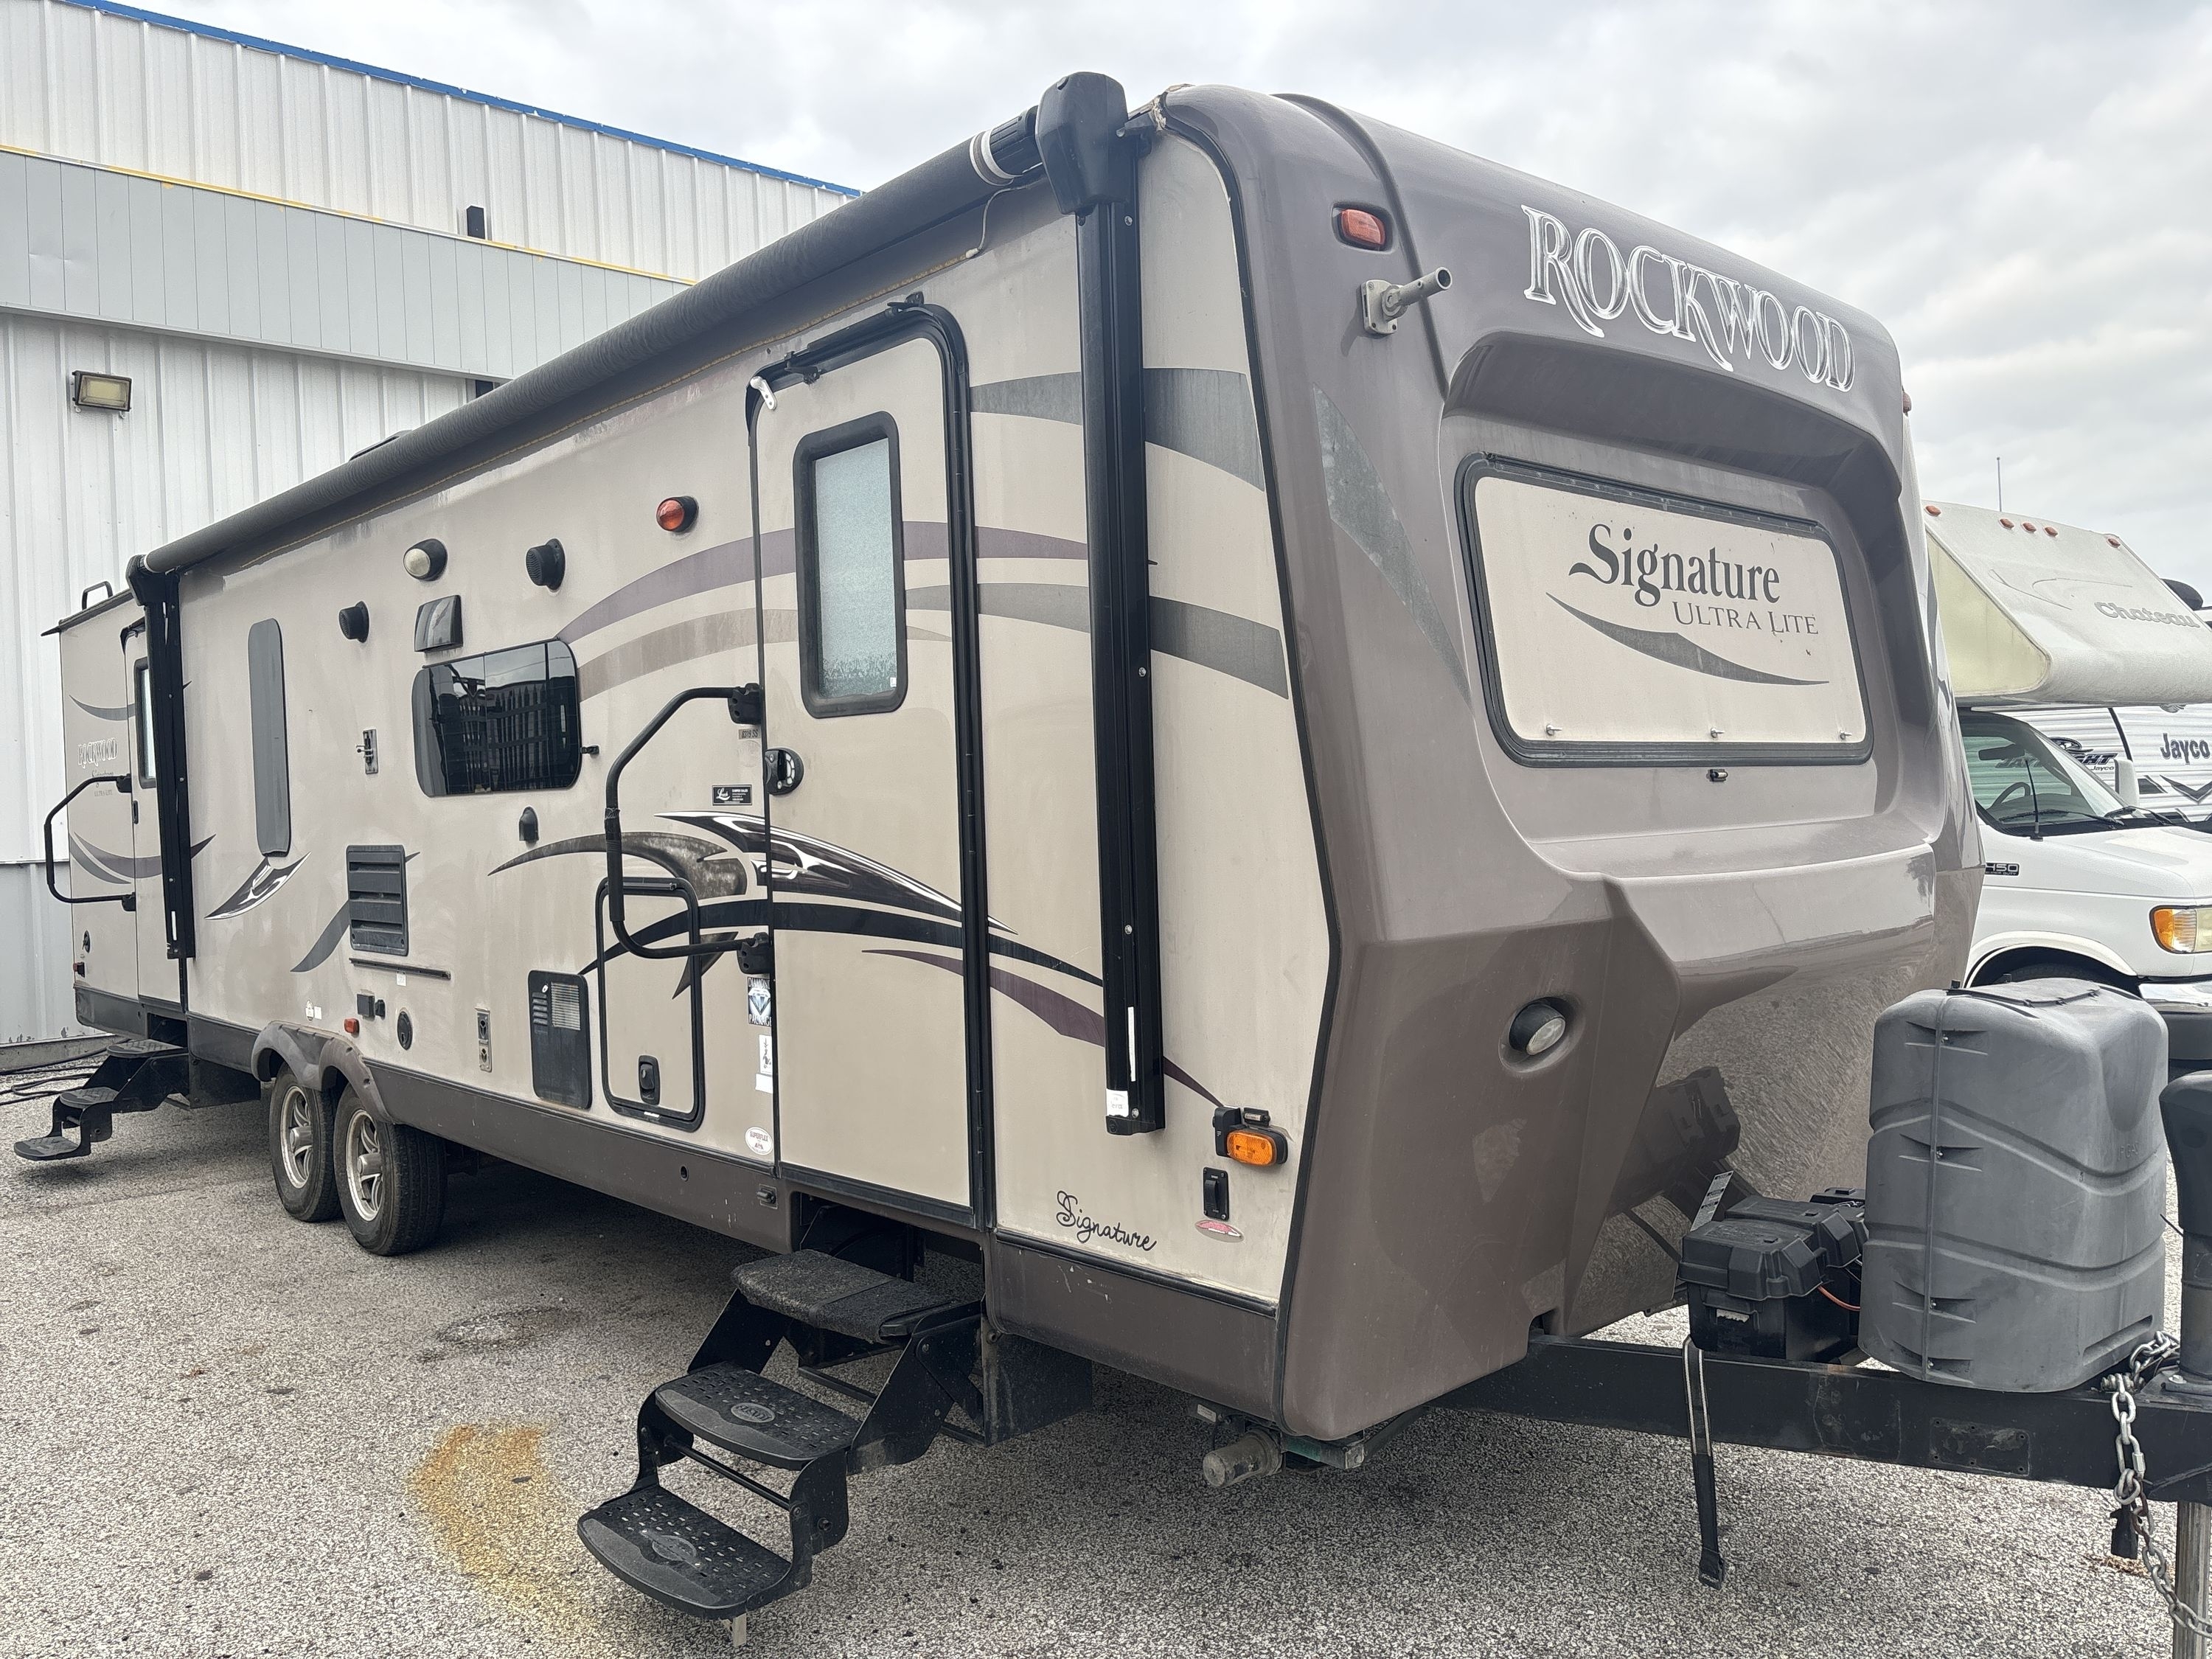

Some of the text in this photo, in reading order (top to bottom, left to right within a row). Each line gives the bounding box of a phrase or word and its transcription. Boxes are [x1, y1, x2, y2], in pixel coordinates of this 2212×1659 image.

[1520, 204, 1856, 392] ROCKWOOD
[1568, 524, 1781, 607] Signature
[1672, 602, 1819, 635] ULTRA LITE
[2094, 602, 2200, 627] Chateau
[77, 737, 118, 769] ROCKWOOD
[2160, 732, 2211, 765] Jayco
[748, 977, 771, 990] DIAMON
[1056, 1190, 1158, 1251] Signature
